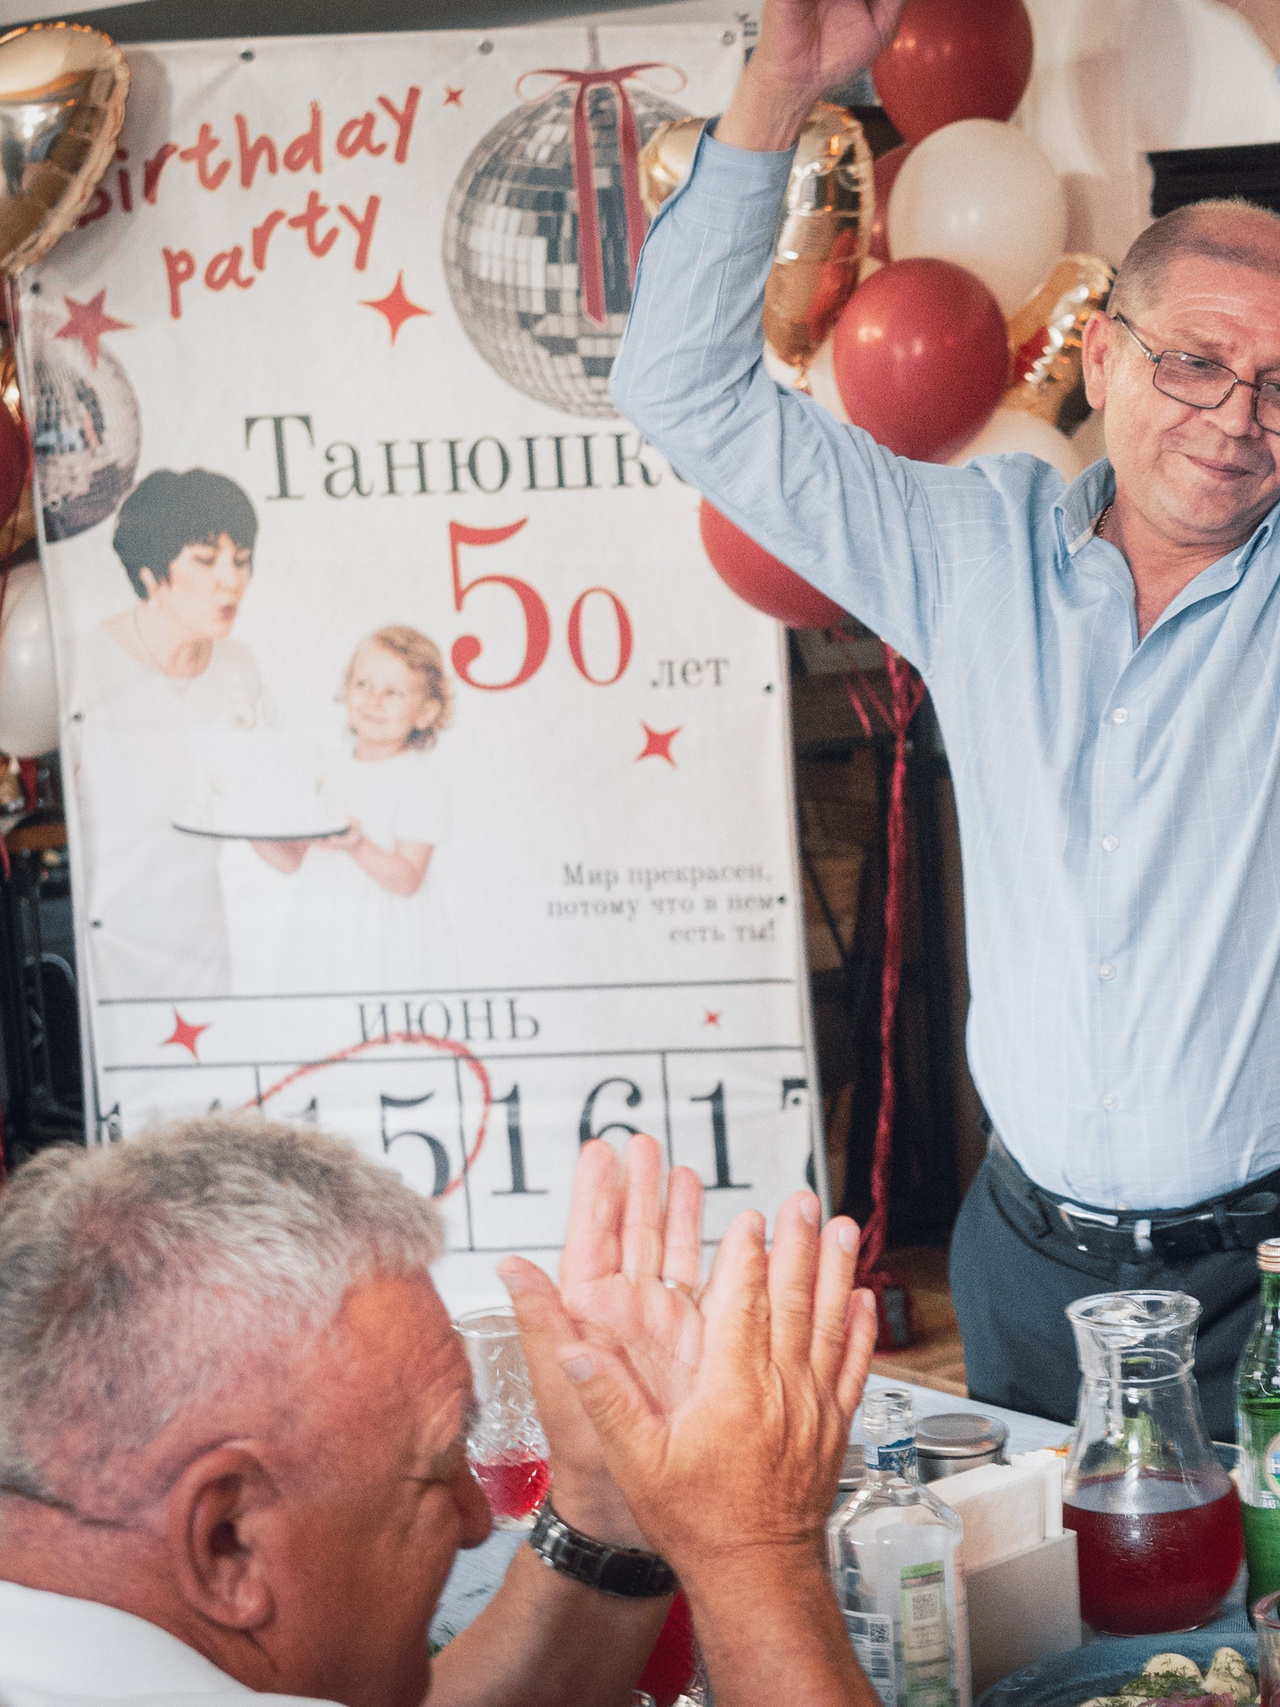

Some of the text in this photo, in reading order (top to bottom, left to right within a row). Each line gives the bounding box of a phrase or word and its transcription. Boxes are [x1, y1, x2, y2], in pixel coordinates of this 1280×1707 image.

[161, 190, 382, 321] party
[244, 413, 690, 502] Танюшк
[448, 516, 731, 692] 50 лет
[562, 862, 773, 892] Мир прекрасен,
[546, 894, 775, 923] потому что в нем
[668, 917, 776, 943] есть ты!
[356, 996, 541, 1044] ИЮНЬ
